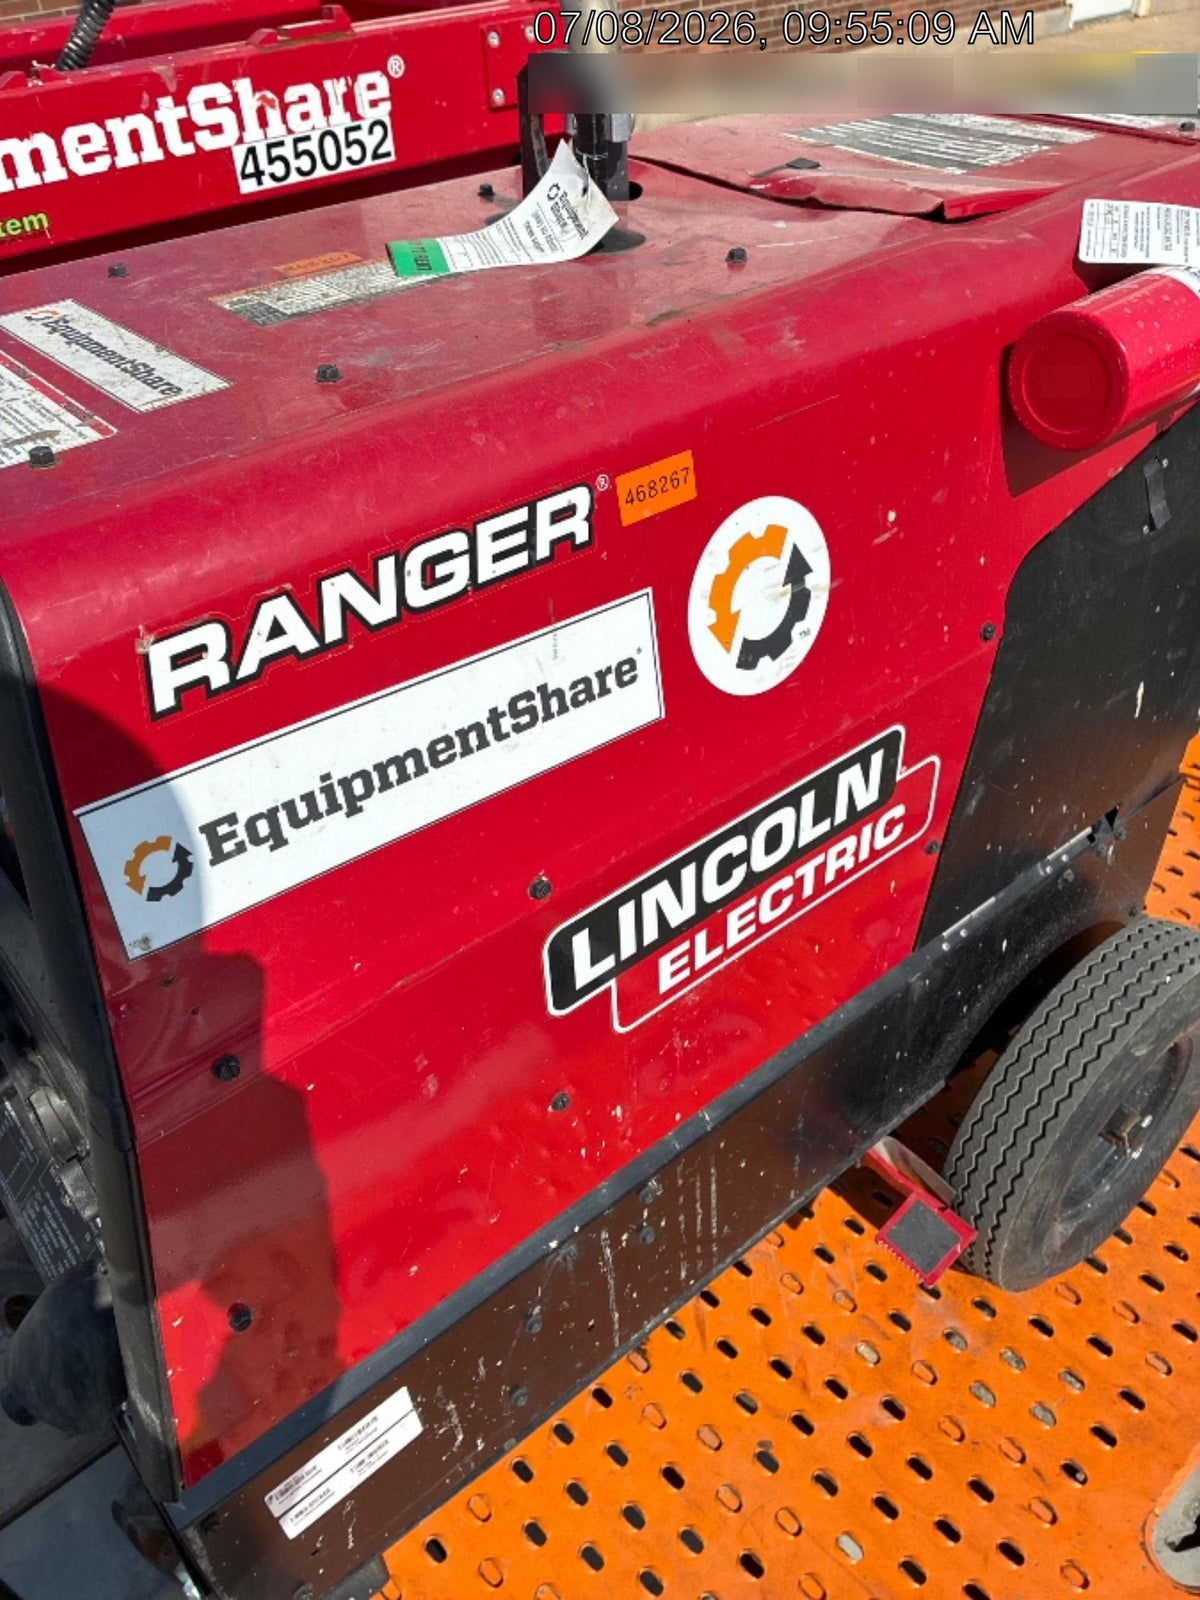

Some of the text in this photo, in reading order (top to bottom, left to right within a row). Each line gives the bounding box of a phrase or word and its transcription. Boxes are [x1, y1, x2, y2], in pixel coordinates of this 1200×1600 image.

[240, 118, 392, 186] 455052
[46, 314, 184, 397] EquipmentShare
[625, 466, 690, 506] 468267
[571, 747, 884, 990] LINCOLN
[658, 803, 905, 996] ELECTRIC
